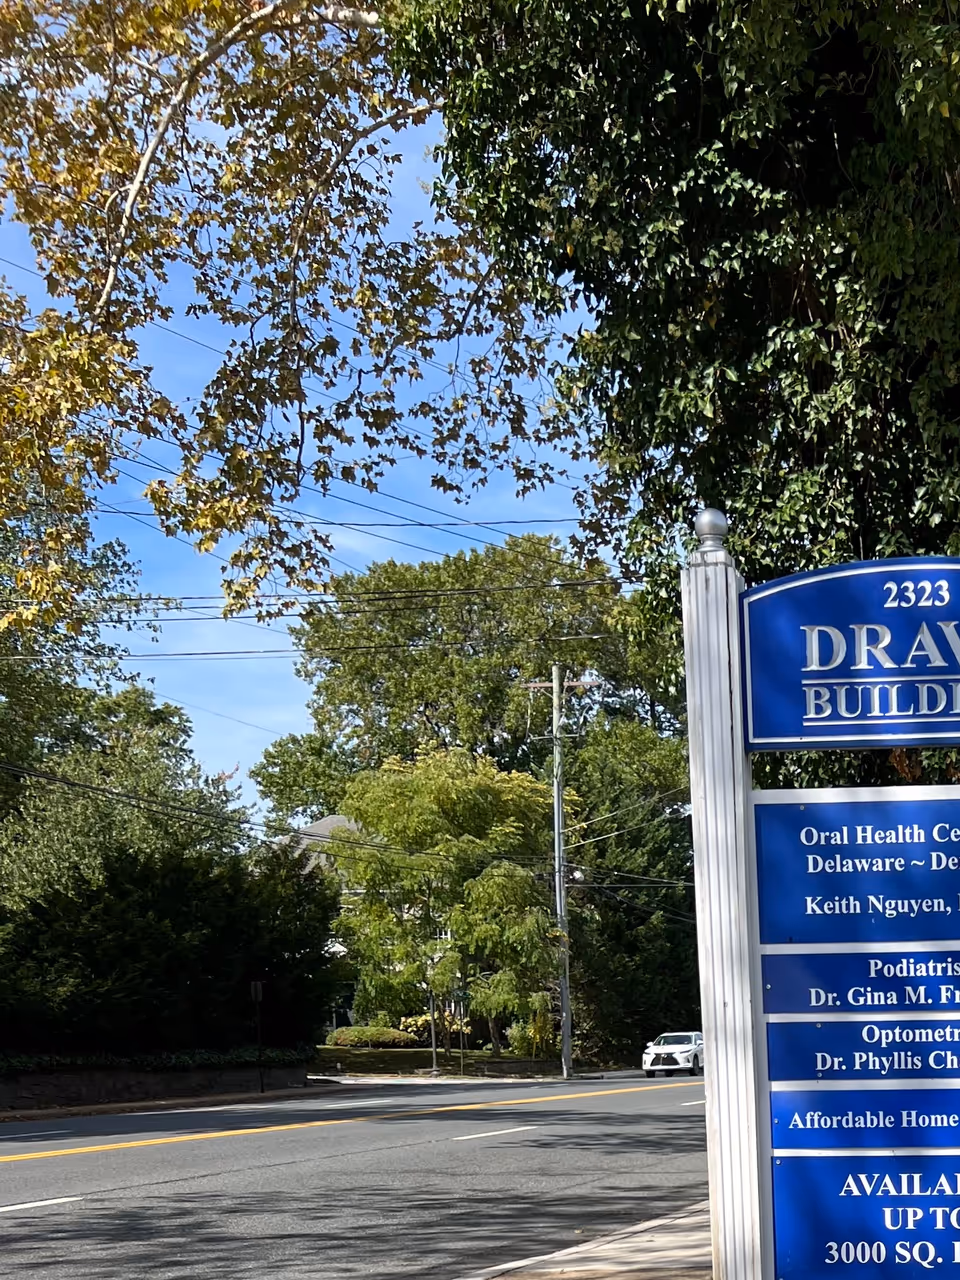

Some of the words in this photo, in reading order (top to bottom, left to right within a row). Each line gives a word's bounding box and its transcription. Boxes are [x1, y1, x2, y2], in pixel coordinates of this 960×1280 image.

[884, 580, 950, 607] 2323
[801, 826, 848, 845] Oral
[856, 824, 925, 844] Health
[807, 855, 904, 872] Delaware
[805, 896, 860, 914] Keith
[868, 895, 951, 917] Nguyen,
[810, 989, 840, 1006] Dr.
[848, 987, 897, 1005] Gina
[905, 986, 932, 1004] M.
[816, 1053, 846, 1070] Dr.
[854, 1052, 921, 1074] Phyllis
[789, 1111, 894, 1128] Affordable
[902, 1111, 958, 1127] Home
[883, 1208, 923, 1230] UP
[825, 1242, 886, 1263] 3000
[896, 1241, 942, 1268] SQ.
